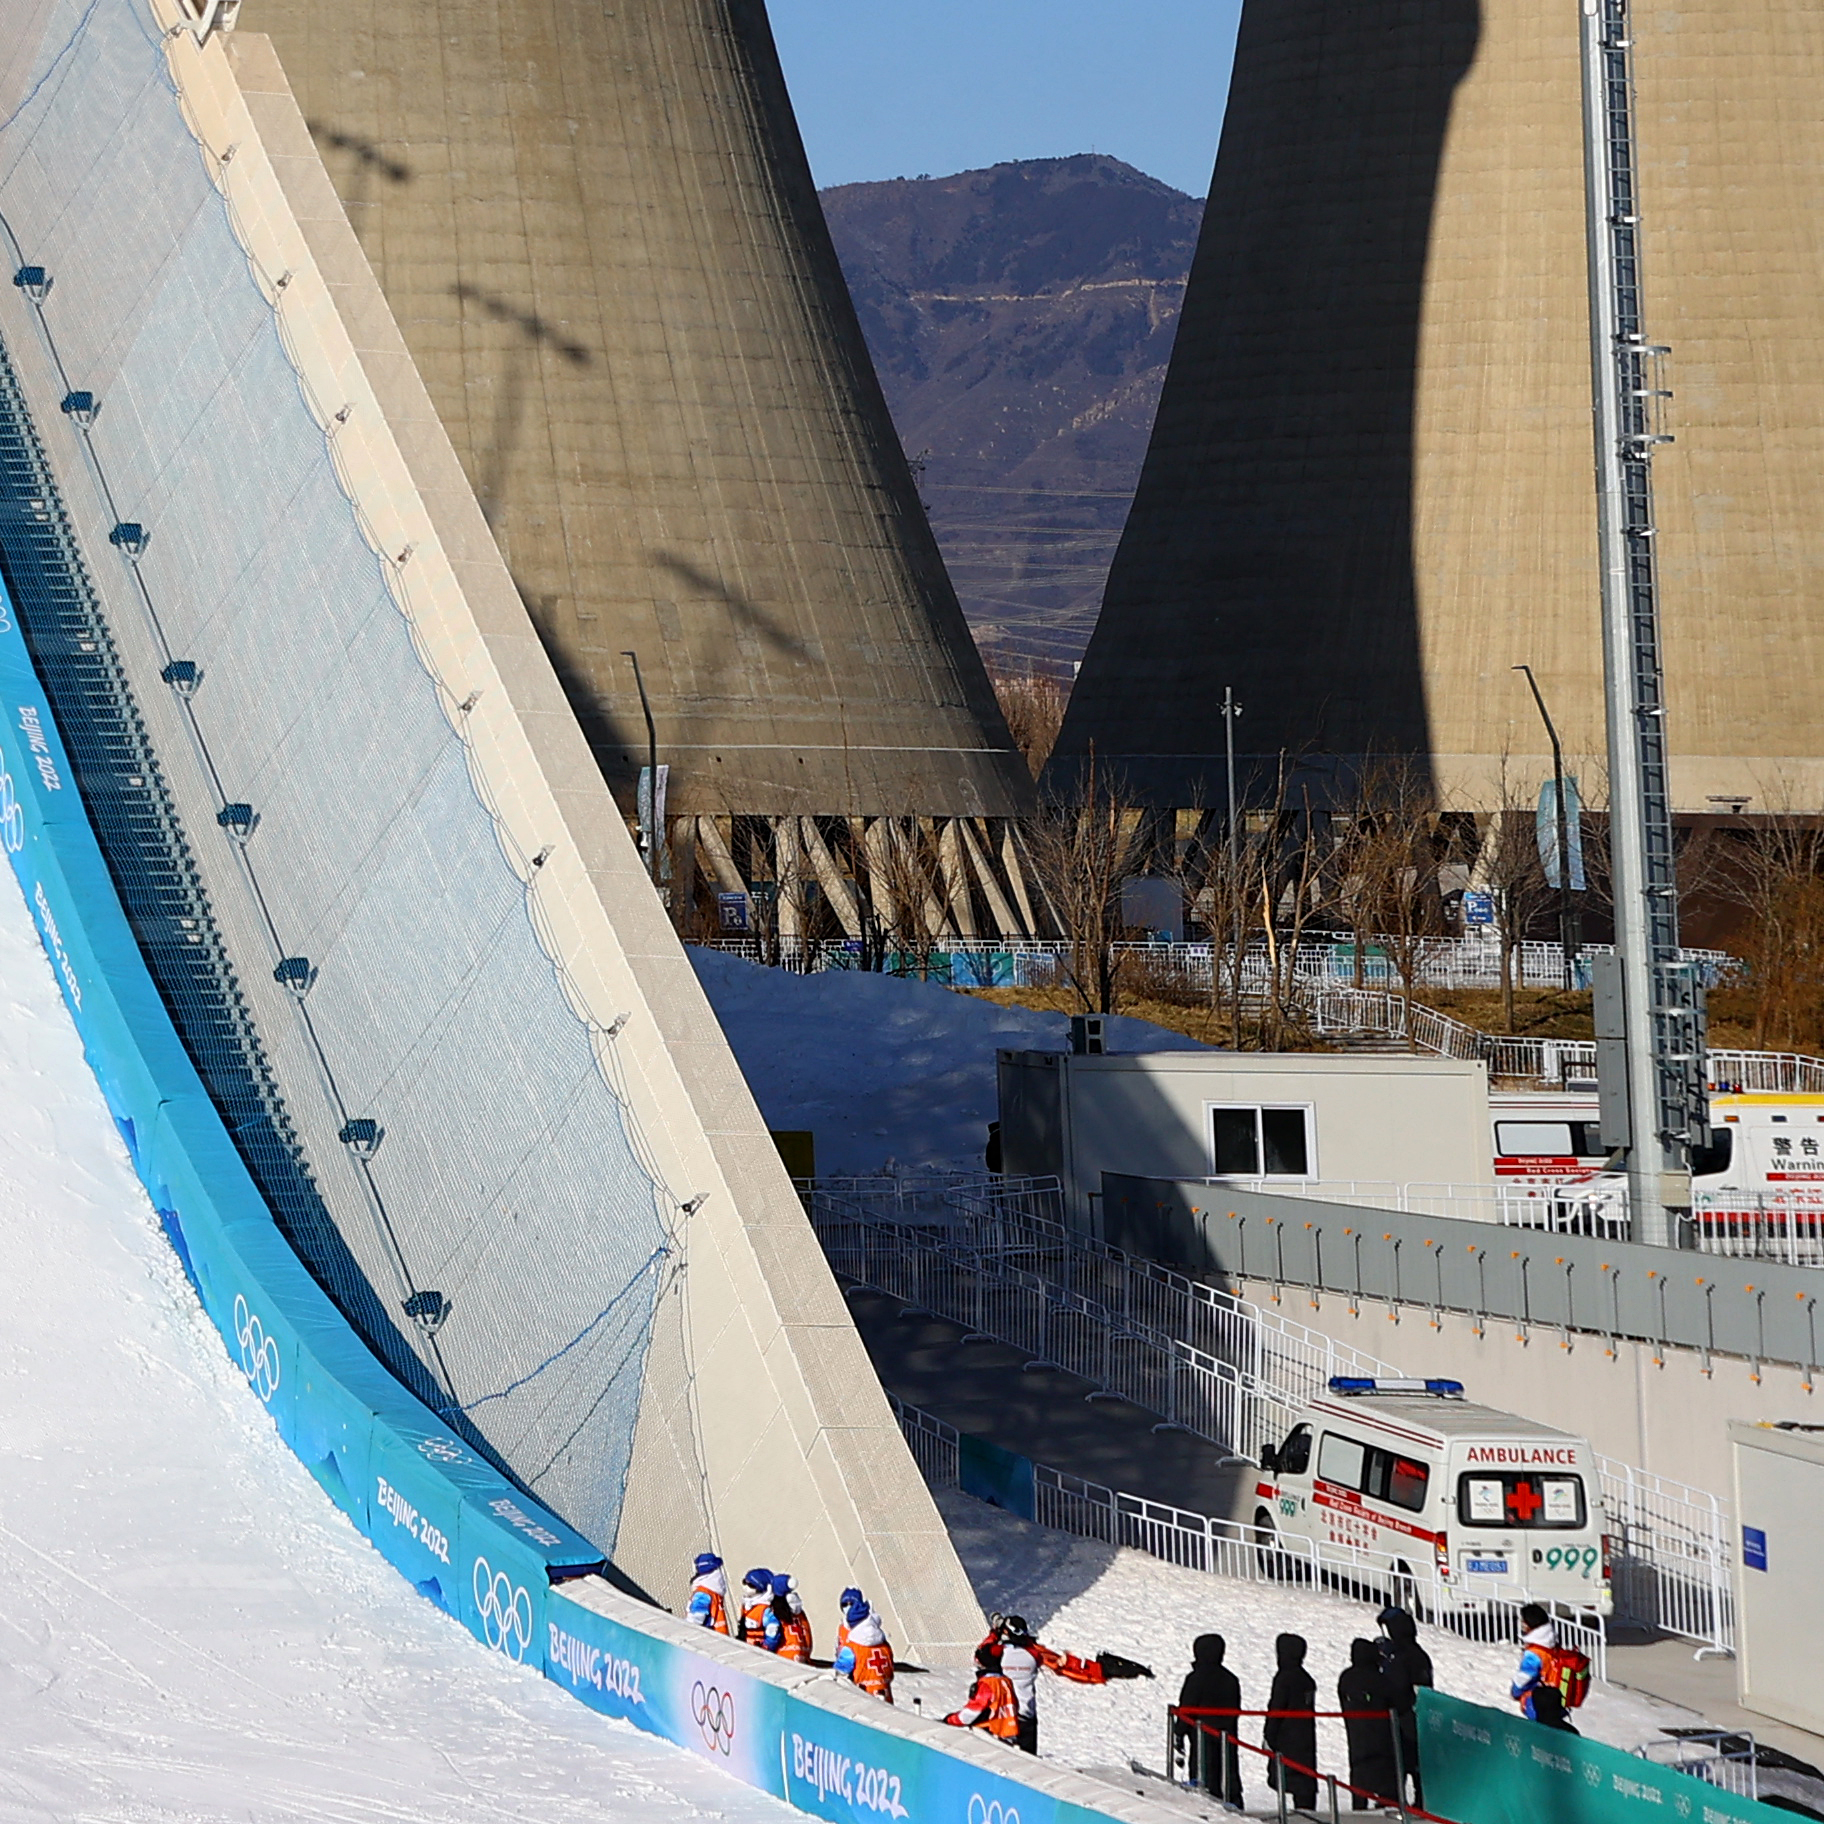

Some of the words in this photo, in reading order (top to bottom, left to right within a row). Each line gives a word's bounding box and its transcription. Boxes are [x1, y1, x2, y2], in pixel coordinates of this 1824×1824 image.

[18, 706, 49, 753] BEIJING
[35, 755, 62, 793] 2022
[35, 880, 63, 960] BEIJING
[61, 951, 82, 1014] 2022
[1467, 1446, 1577, 1465] AMBULANCE
[376, 1476, 419, 1539] BEIJING
[420, 1517, 452, 1566] 2022
[488, 1498, 536, 1527] BEIJING
[522, 1526, 562, 1548] 2022
[1279, 1498, 1296, 1518] 999
[1546, 1547, 1598, 1572] 999
[548, 1622, 602, 1691] BEIJING
[604, 1653, 646, 1704] 2022
[791, 1733, 852, 1806] BEIJING
[854, 1762, 910, 1820] 2022
[1613, 1773, 1641, 1799] BEIJING
[1641, 1783, 1663, 1805] 2022
